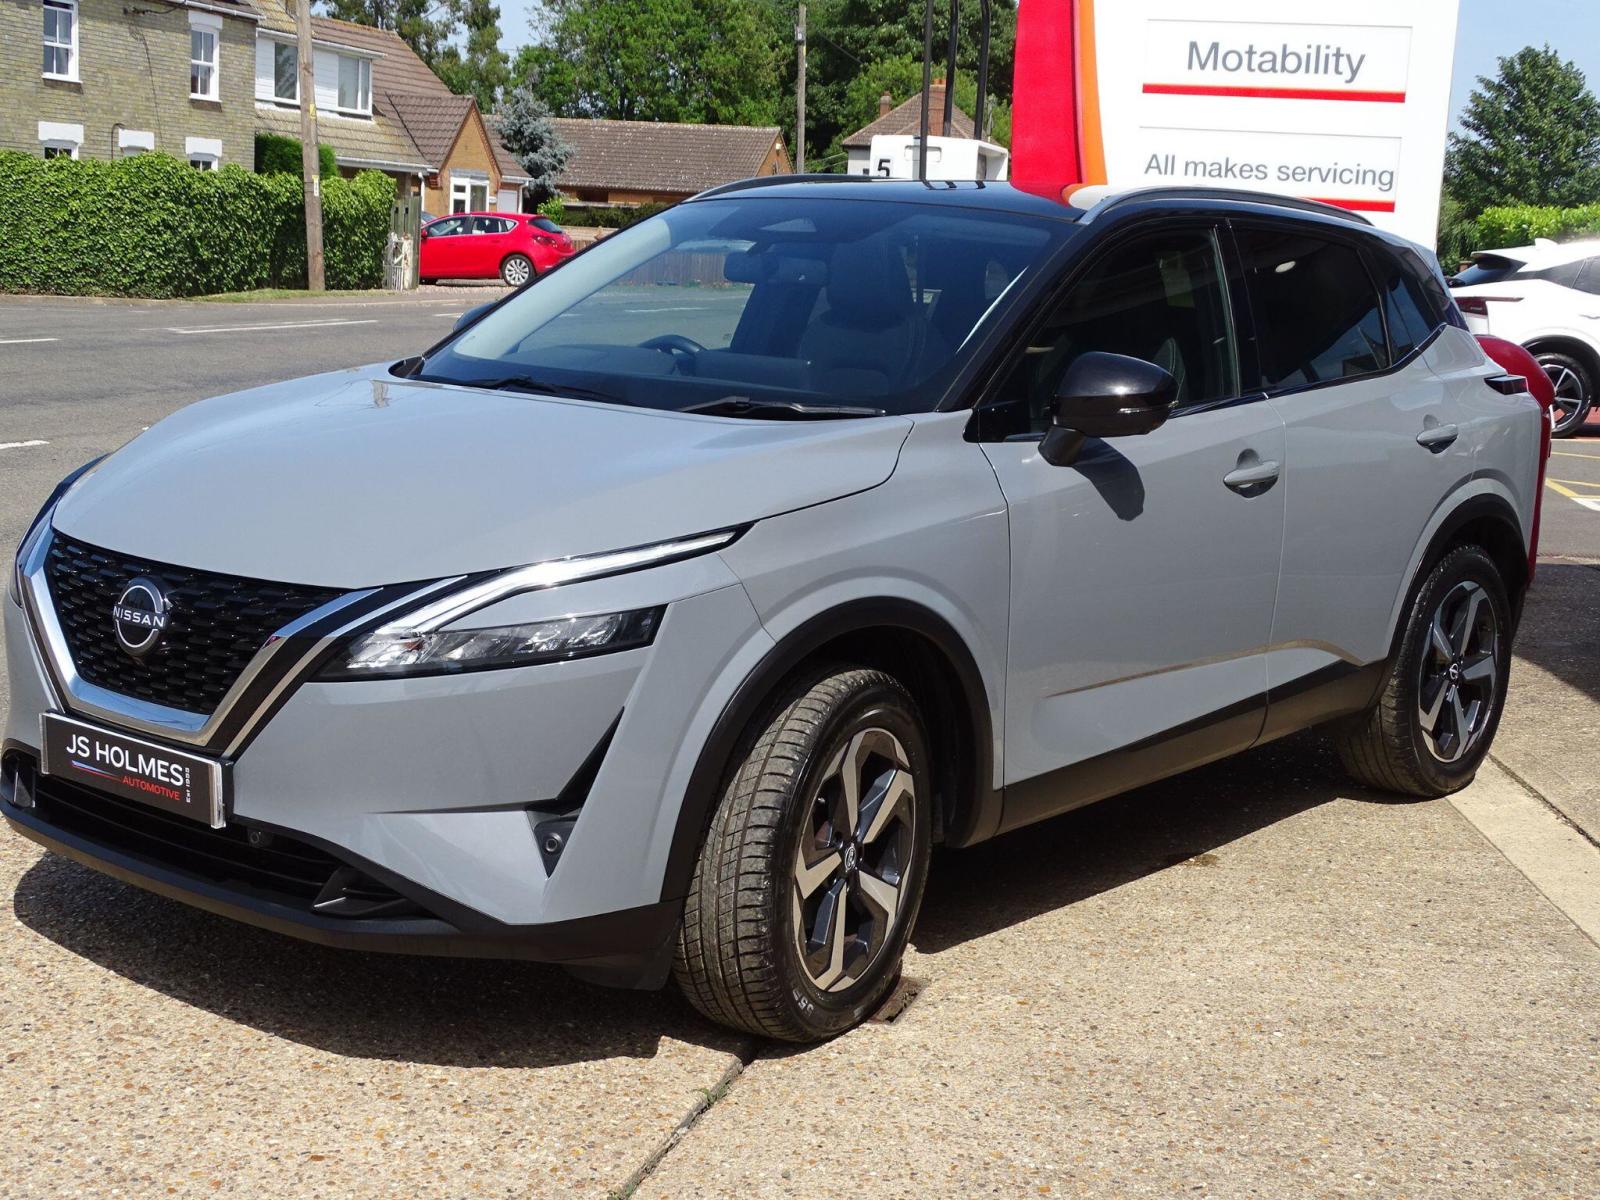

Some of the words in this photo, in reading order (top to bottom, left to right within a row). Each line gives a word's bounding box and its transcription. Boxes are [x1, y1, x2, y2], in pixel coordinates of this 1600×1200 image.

[1187, 40, 1366, 84] Motability
[1144, 153, 1175, 176] All
[1184, 157, 1268, 181] makes
[1277, 162, 1395, 192] servicing
[113, 605, 165, 628] NISSAN
[66, 734, 90, 758] JS
[95, 741, 184, 787] HOLMES
[122, 775, 181, 801] AUTOMOTIVE
